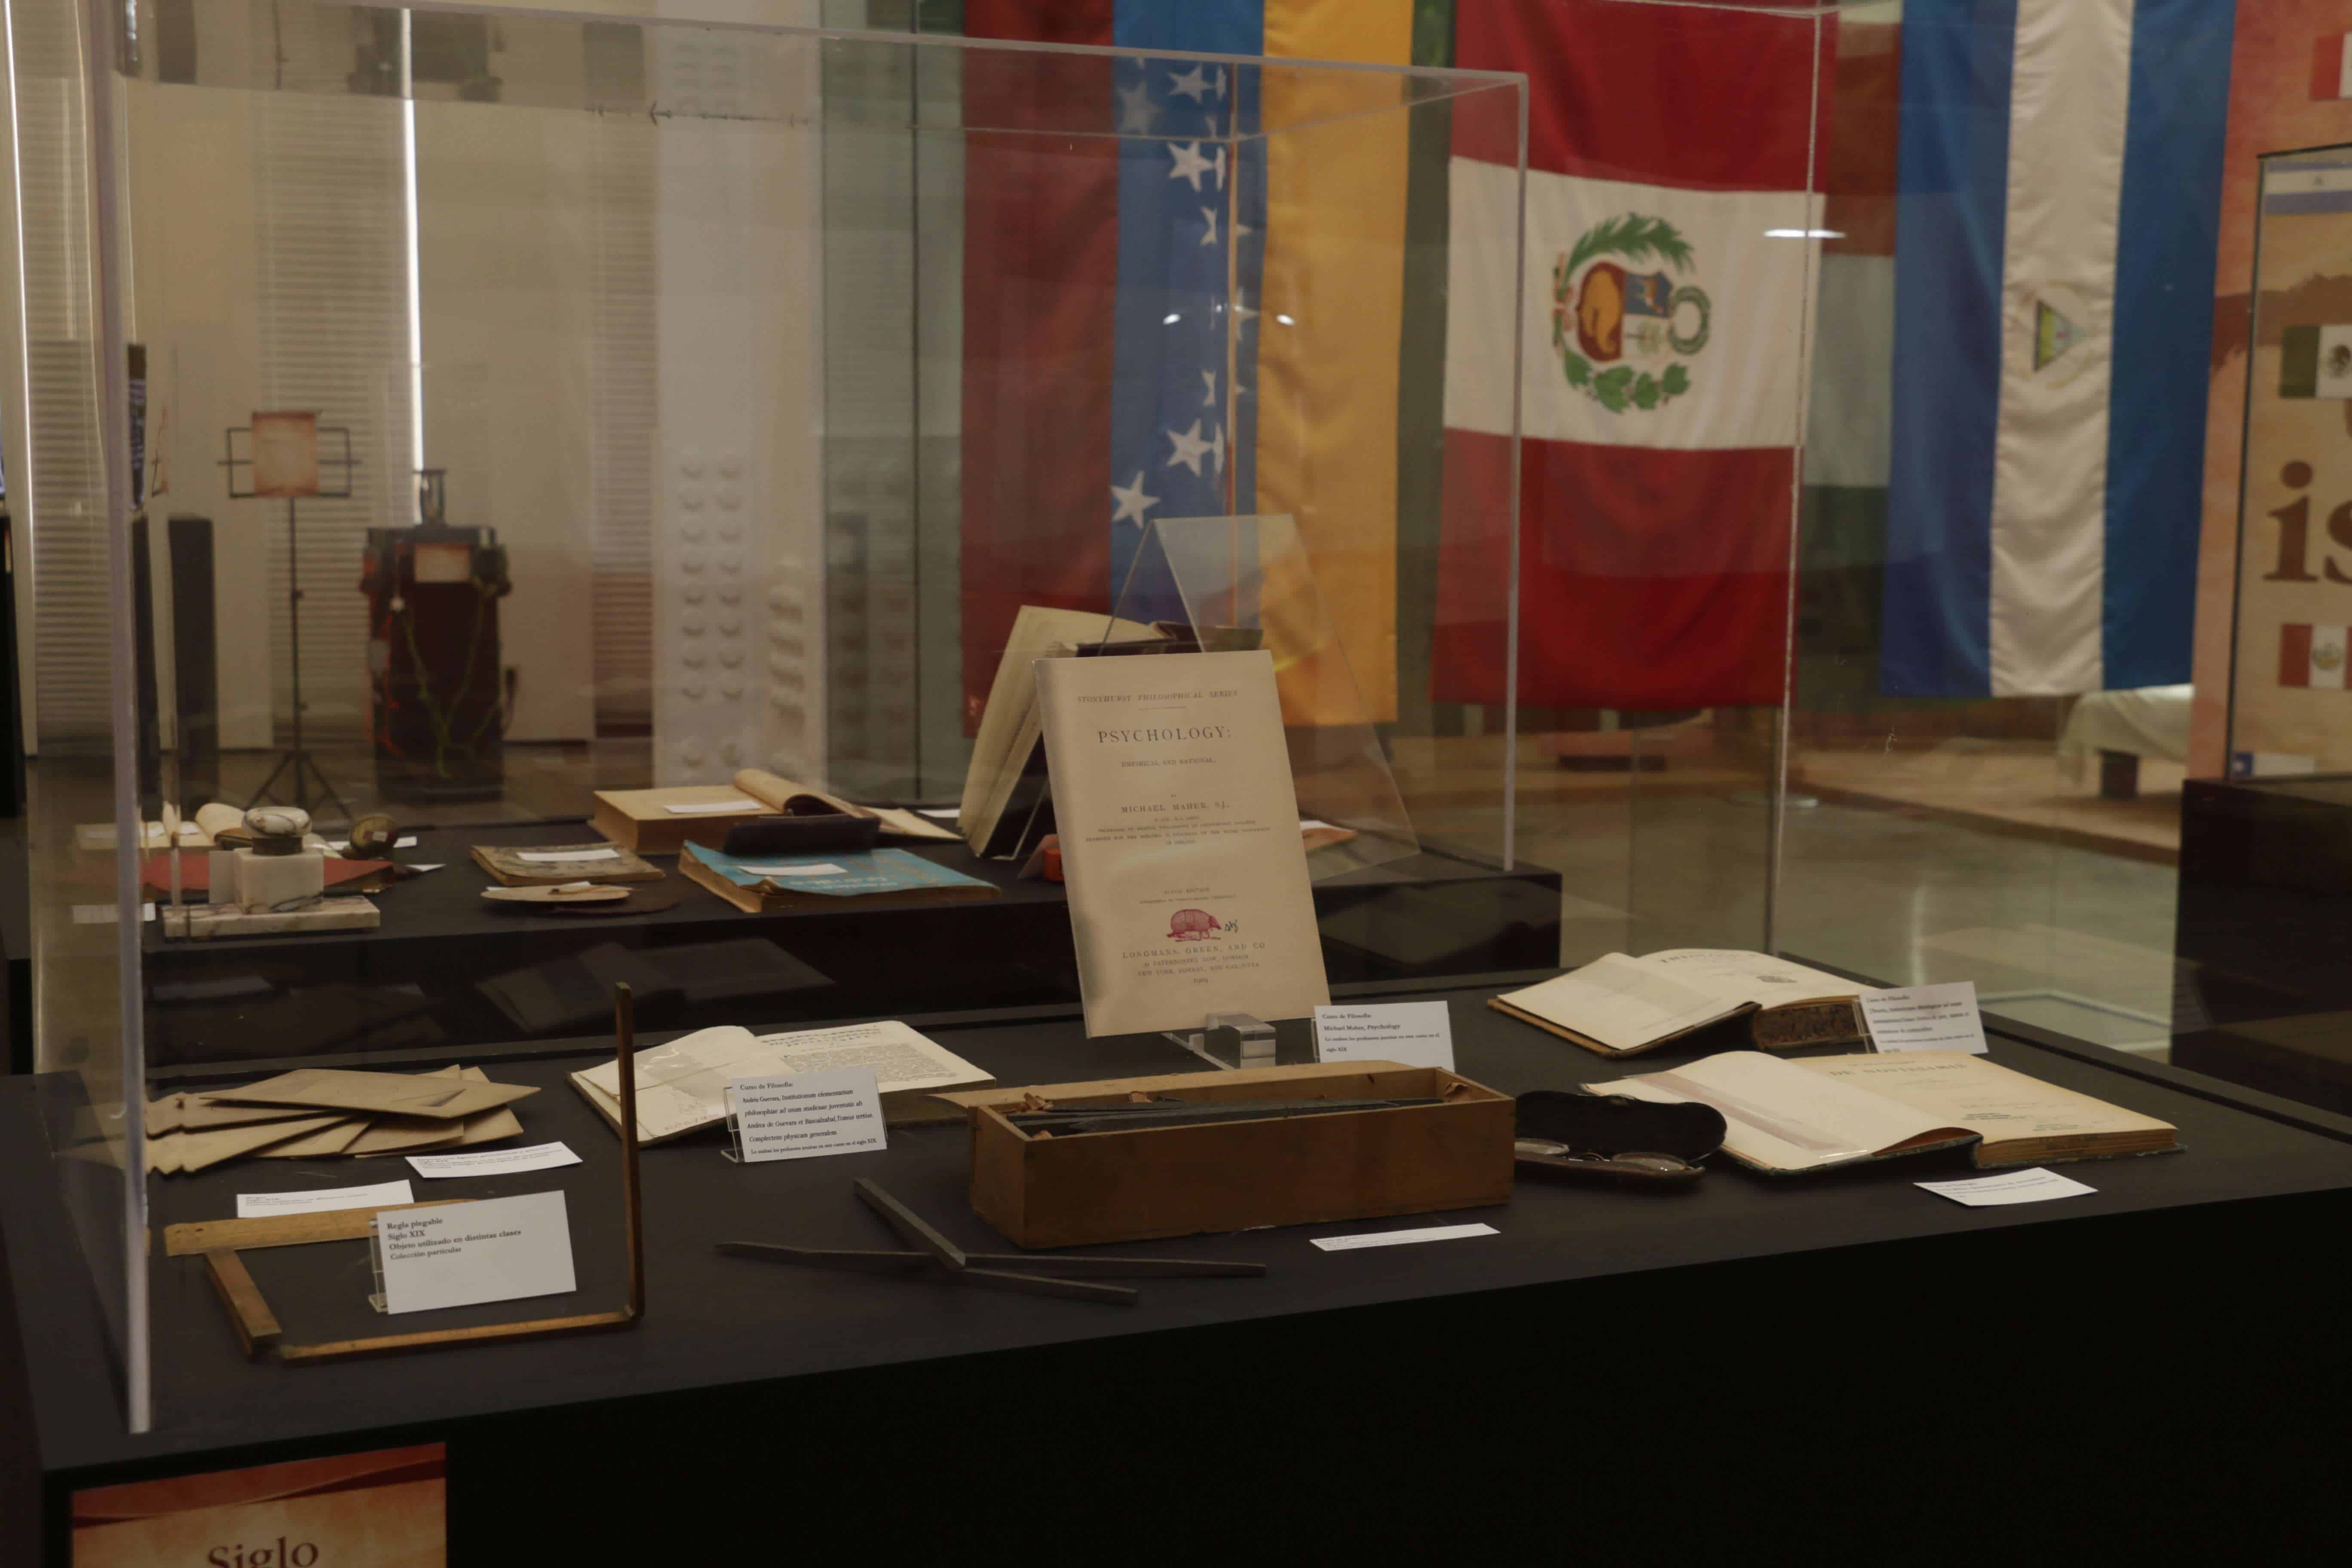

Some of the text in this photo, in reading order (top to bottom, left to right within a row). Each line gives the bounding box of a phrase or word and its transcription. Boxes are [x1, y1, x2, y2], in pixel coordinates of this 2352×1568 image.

[1098, 726, 1231, 743] PSYCHOLOGY:
[1121, 804, 1166, 812] MICHAEL
[1367, 1023, 1401, 1032] Psychology
[818, 1089, 853, 1098] elementarium
[744, 1107, 778, 1118] philosophiae
[749, 1134, 782, 1143] Complectens
[784, 1133, 808, 1142] physicam
[387, 1217, 444, 1231] Regla plegable
[388, 1230, 426, 1241] Siglo XIX
[389, 1243, 416, 1251] Objeto
[417, 1237, 452, 1248] utilizado
[465, 1232, 497, 1242] distintas
[499, 1228, 522, 1237] clases
[427, 1246, 462, 1258] particular
